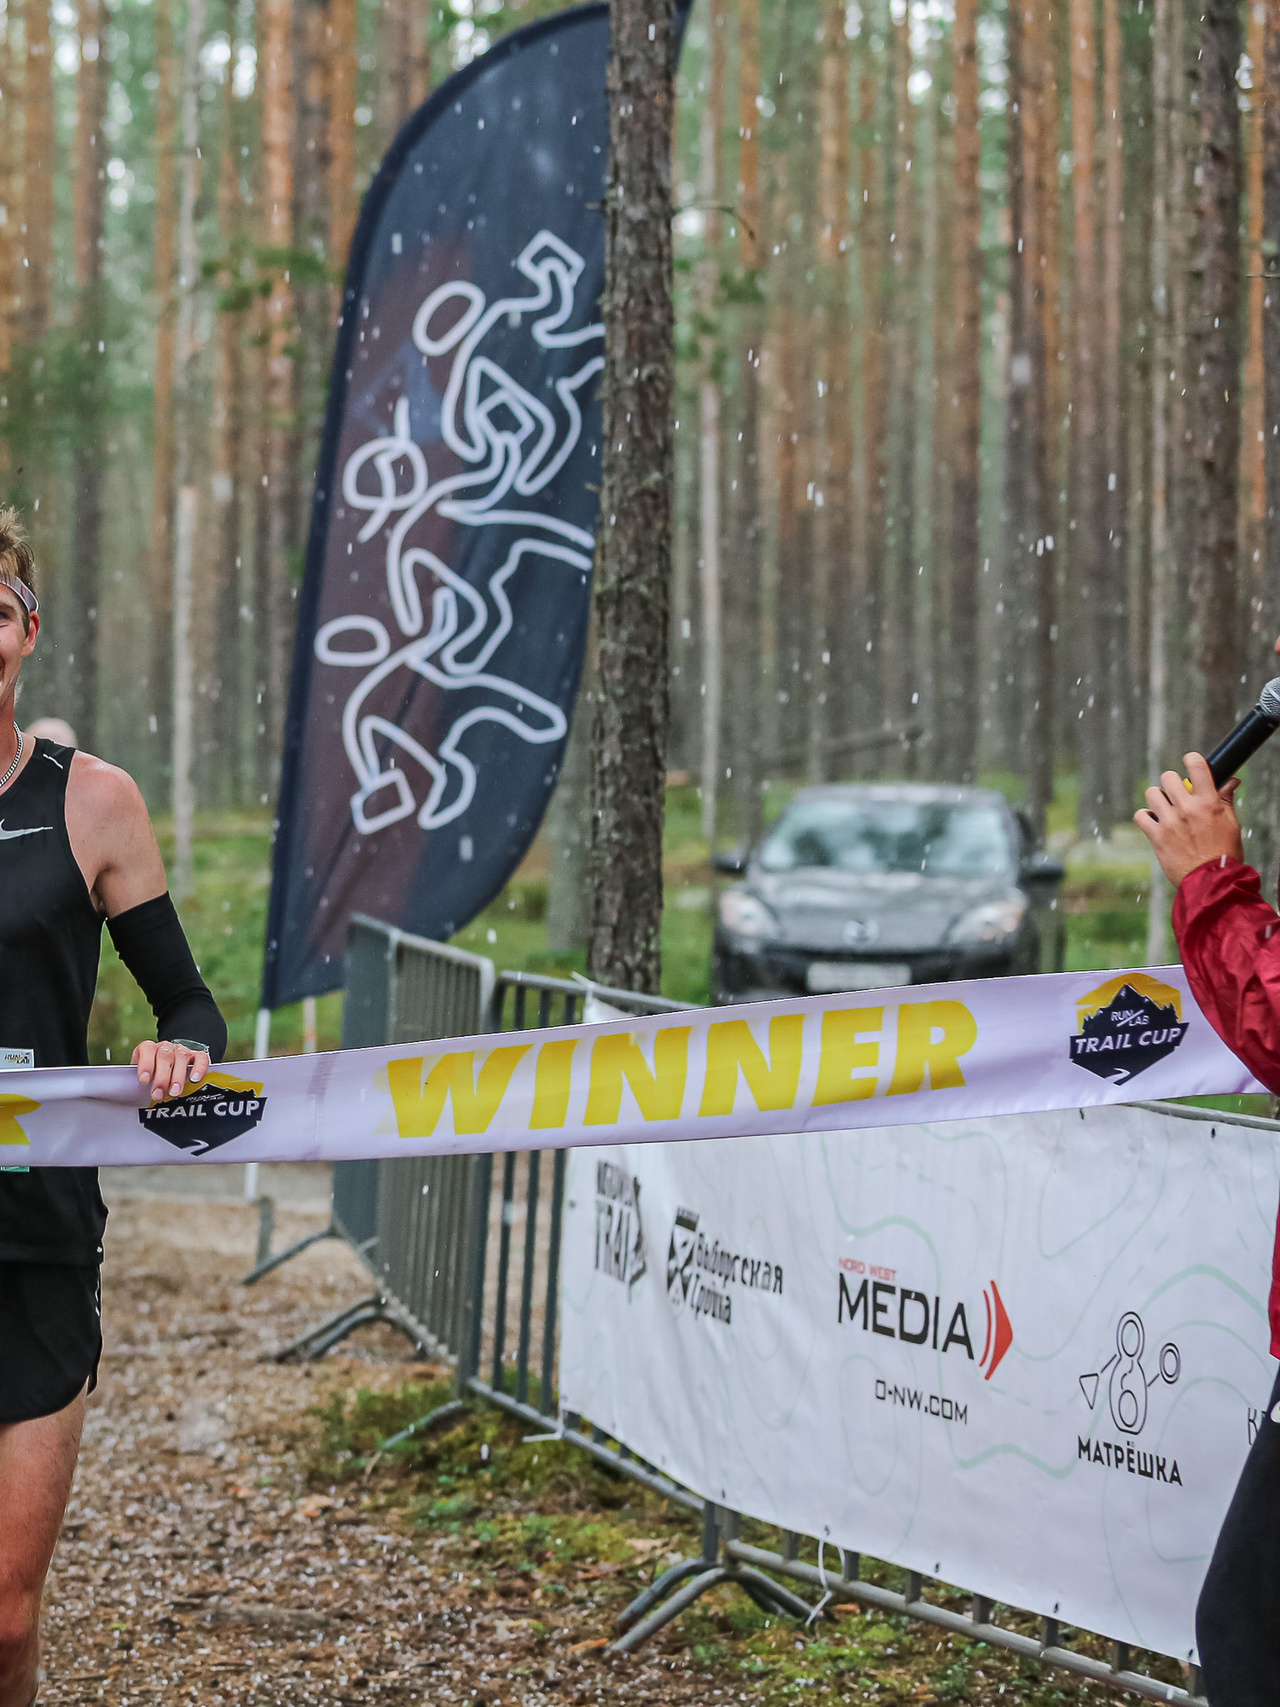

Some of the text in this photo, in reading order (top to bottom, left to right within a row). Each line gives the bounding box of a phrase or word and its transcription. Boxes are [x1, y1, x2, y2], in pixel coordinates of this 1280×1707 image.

[1111, 1010, 1134, 1021] RUN
[1128, 1015, 1150, 1027] LAB
[1075, 1027, 1182, 1054] TRAIL CUP
[386, 999, 978, 1139] WINNER
[145, 1100, 261, 1119] TRAIL CUP
[838, 1256, 897, 1282] NORD WEST
[837, 1271, 975, 1361] MEDIA
[1077, 1434, 1184, 1488] МАТРЁШКА
